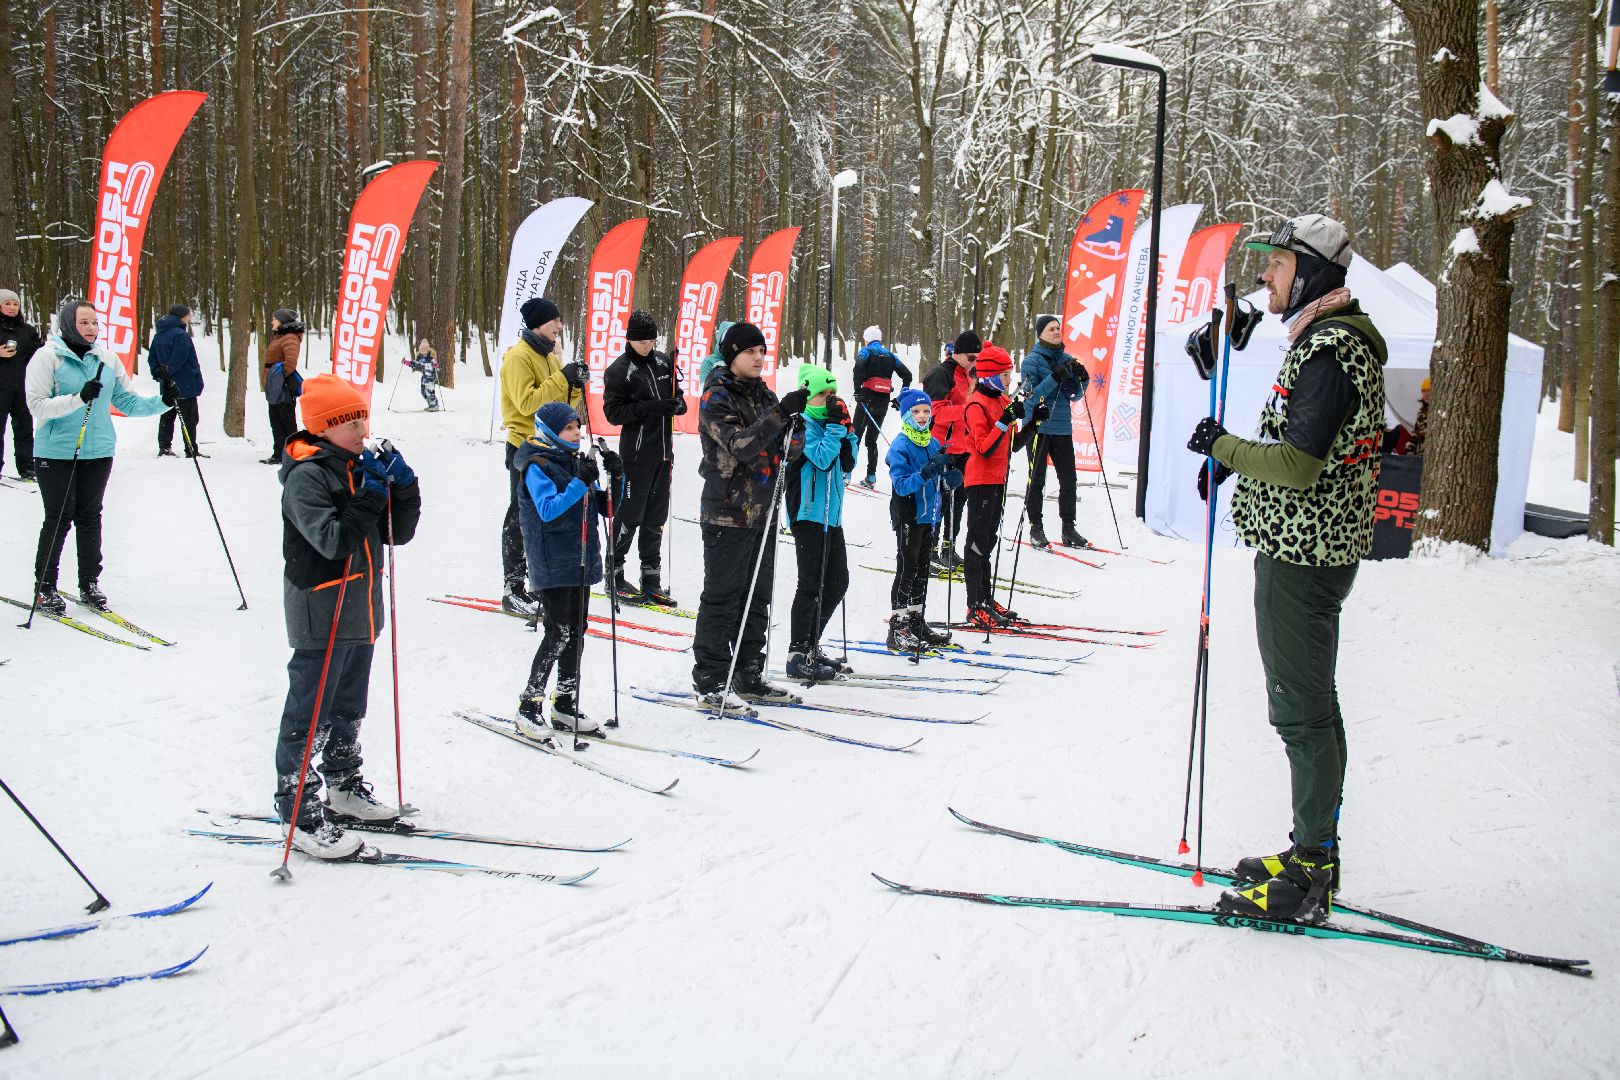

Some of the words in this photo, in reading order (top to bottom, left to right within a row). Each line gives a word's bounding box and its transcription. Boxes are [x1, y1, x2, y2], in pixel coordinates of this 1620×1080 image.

[1131, 247, 1150, 304] КАЧЕСТВА
[1122, 305, 1139, 364] ЛЫЖНОГО
[1117, 366, 1129, 395] ЗНАК
